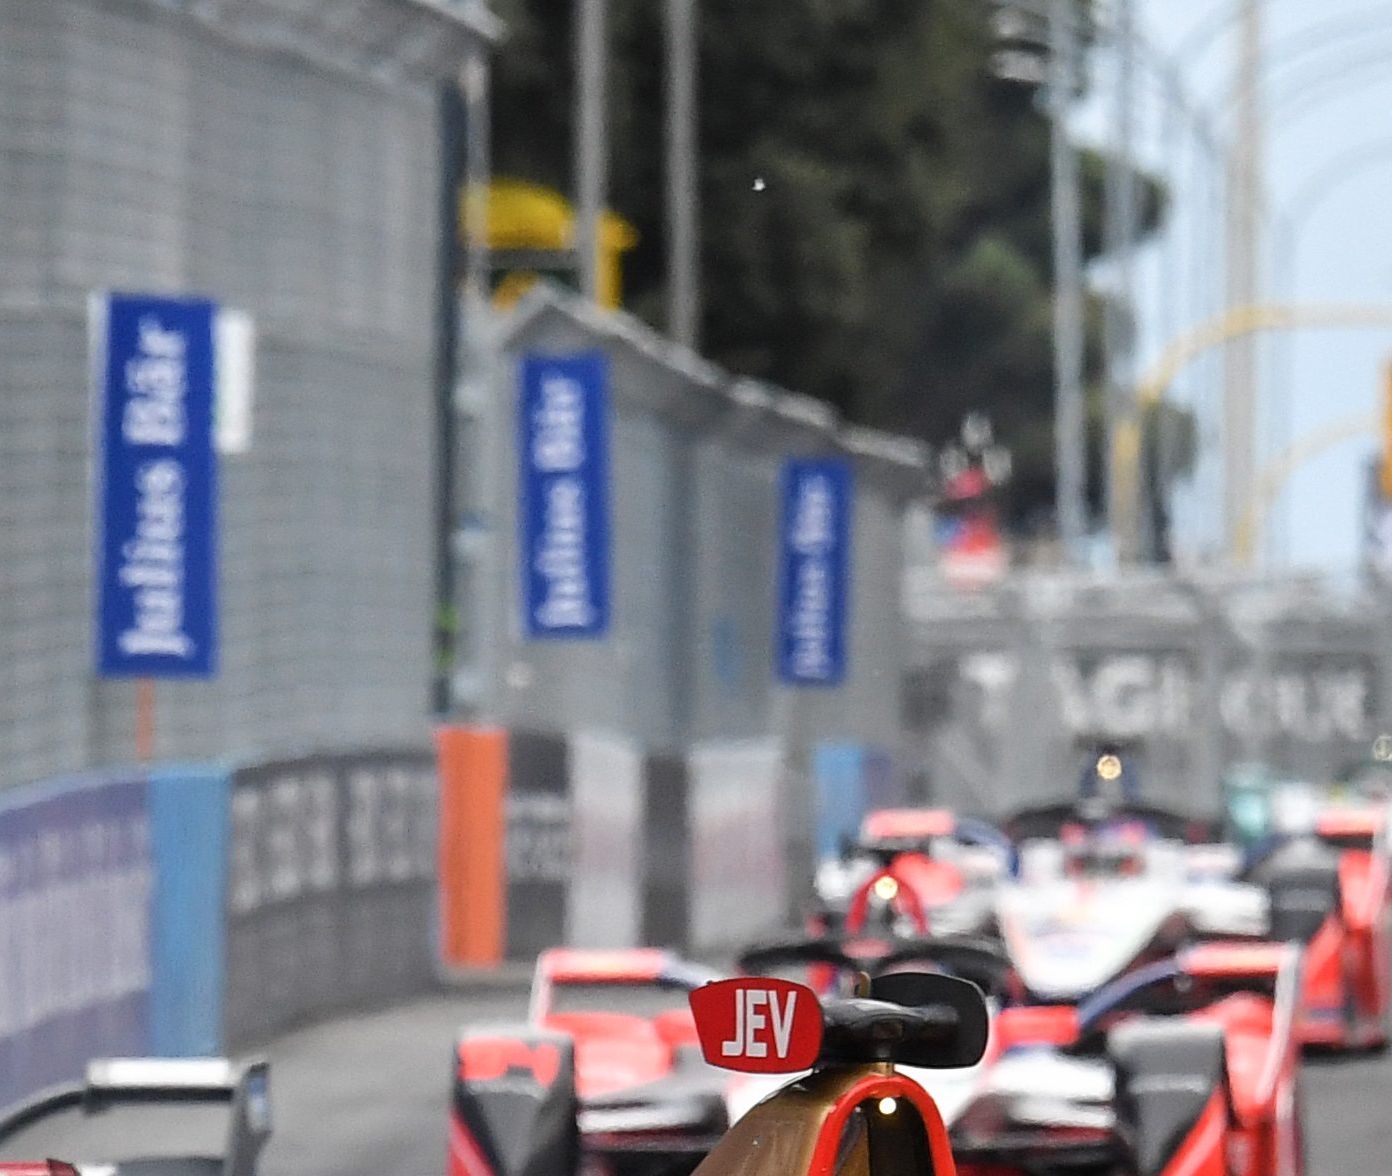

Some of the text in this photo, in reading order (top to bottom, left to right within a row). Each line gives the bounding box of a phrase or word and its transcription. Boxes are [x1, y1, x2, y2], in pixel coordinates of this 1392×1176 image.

[118, 315, 194, 657] Julius Bär
[721, 988, 797, 1059] JEV
